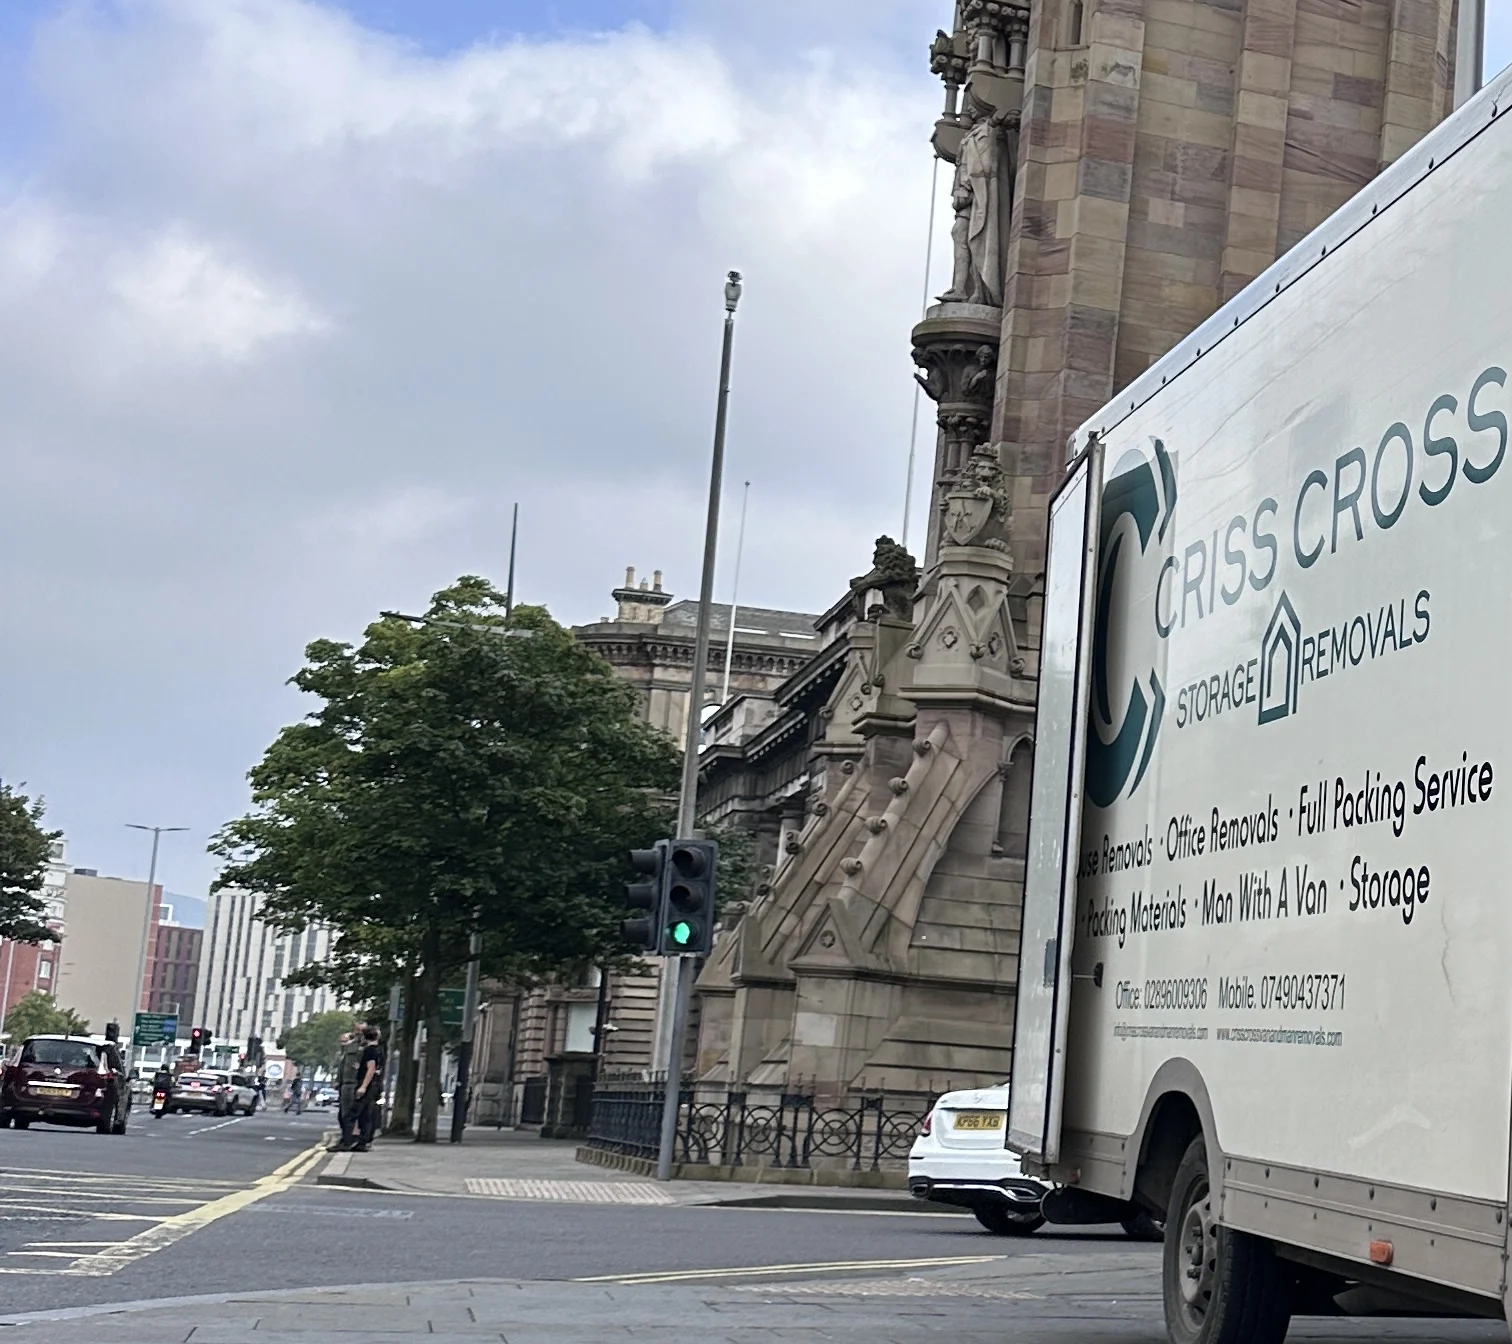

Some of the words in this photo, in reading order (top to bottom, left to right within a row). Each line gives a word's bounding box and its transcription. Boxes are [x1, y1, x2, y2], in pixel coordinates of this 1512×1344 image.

[1155, 497, 1279, 639] CRISS
[1293, 366, 1508, 569] CROSS
[1176, 657, 1258, 729] STORAGE
[1300, 589, 1431, 686] REMOVALS
[1101, 824, 1153, 875] Removals
[1166, 813, 1206, 862] Office
[1210, 793, 1279, 853] Removals
[1298, 779, 1328, 837] Full
[1333, 769, 1406, 838] Packing
[1413, 750, 1493, 815] Service
[1087, 896, 1127, 950] Packing
[1130, 884, 1186, 934] Materials
[1201, 878, 1233, 927] Man
[1239, 869, 1272, 922] With
[1277, 866, 1289, 919] A
[1296, 864, 1327, 917] Van
[1349, 855, 1431, 925] Storage
[1260, 973, 1346, 1011] 07490437371
